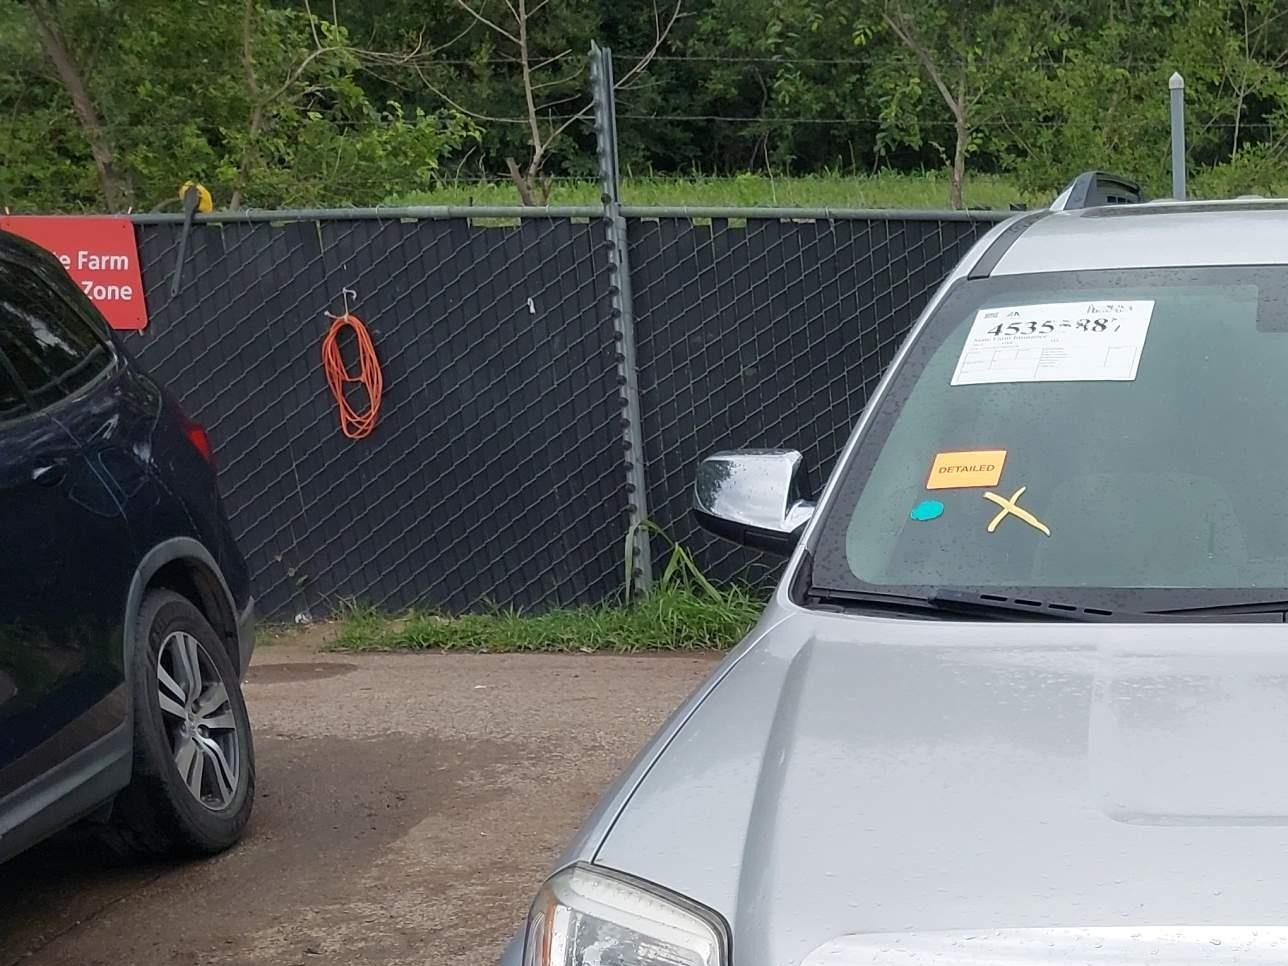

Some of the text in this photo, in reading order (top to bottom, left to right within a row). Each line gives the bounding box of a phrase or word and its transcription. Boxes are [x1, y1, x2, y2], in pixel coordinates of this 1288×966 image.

[77, 250, 129, 270] Farm
[81, 280, 133, 301] Zone
[938, 463, 996, 475] DETAILED
